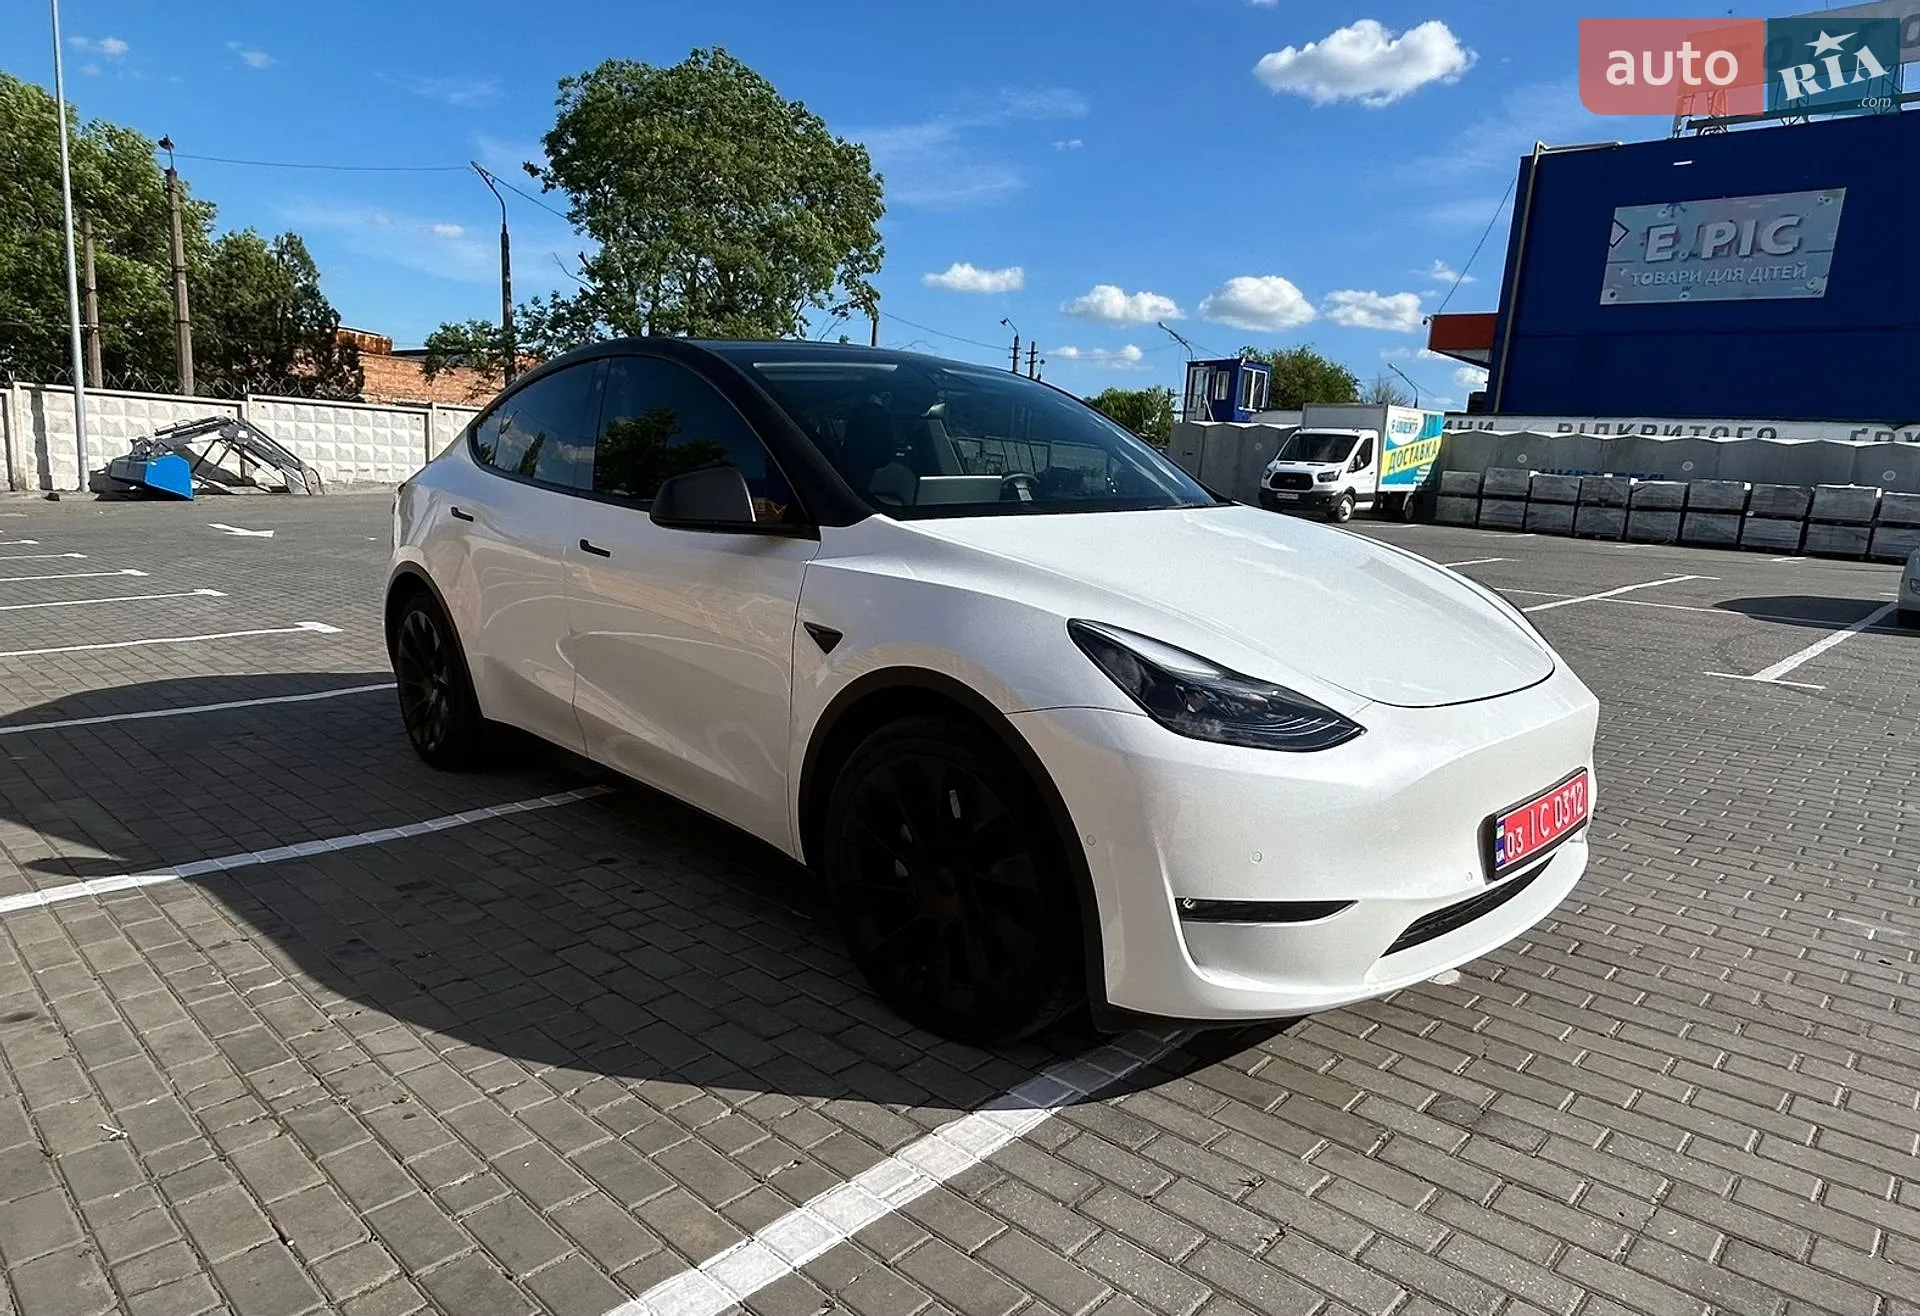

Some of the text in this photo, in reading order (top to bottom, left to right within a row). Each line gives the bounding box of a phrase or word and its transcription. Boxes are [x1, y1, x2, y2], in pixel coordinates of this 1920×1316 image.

[1631, 261, 1808, 287] ТОВАРИ ДЛЯ ДІТЕЙ
[1388, 440, 1438, 472] ДОСТАВКА
[1506, 781, 1584, 859] 03 IC 0312
